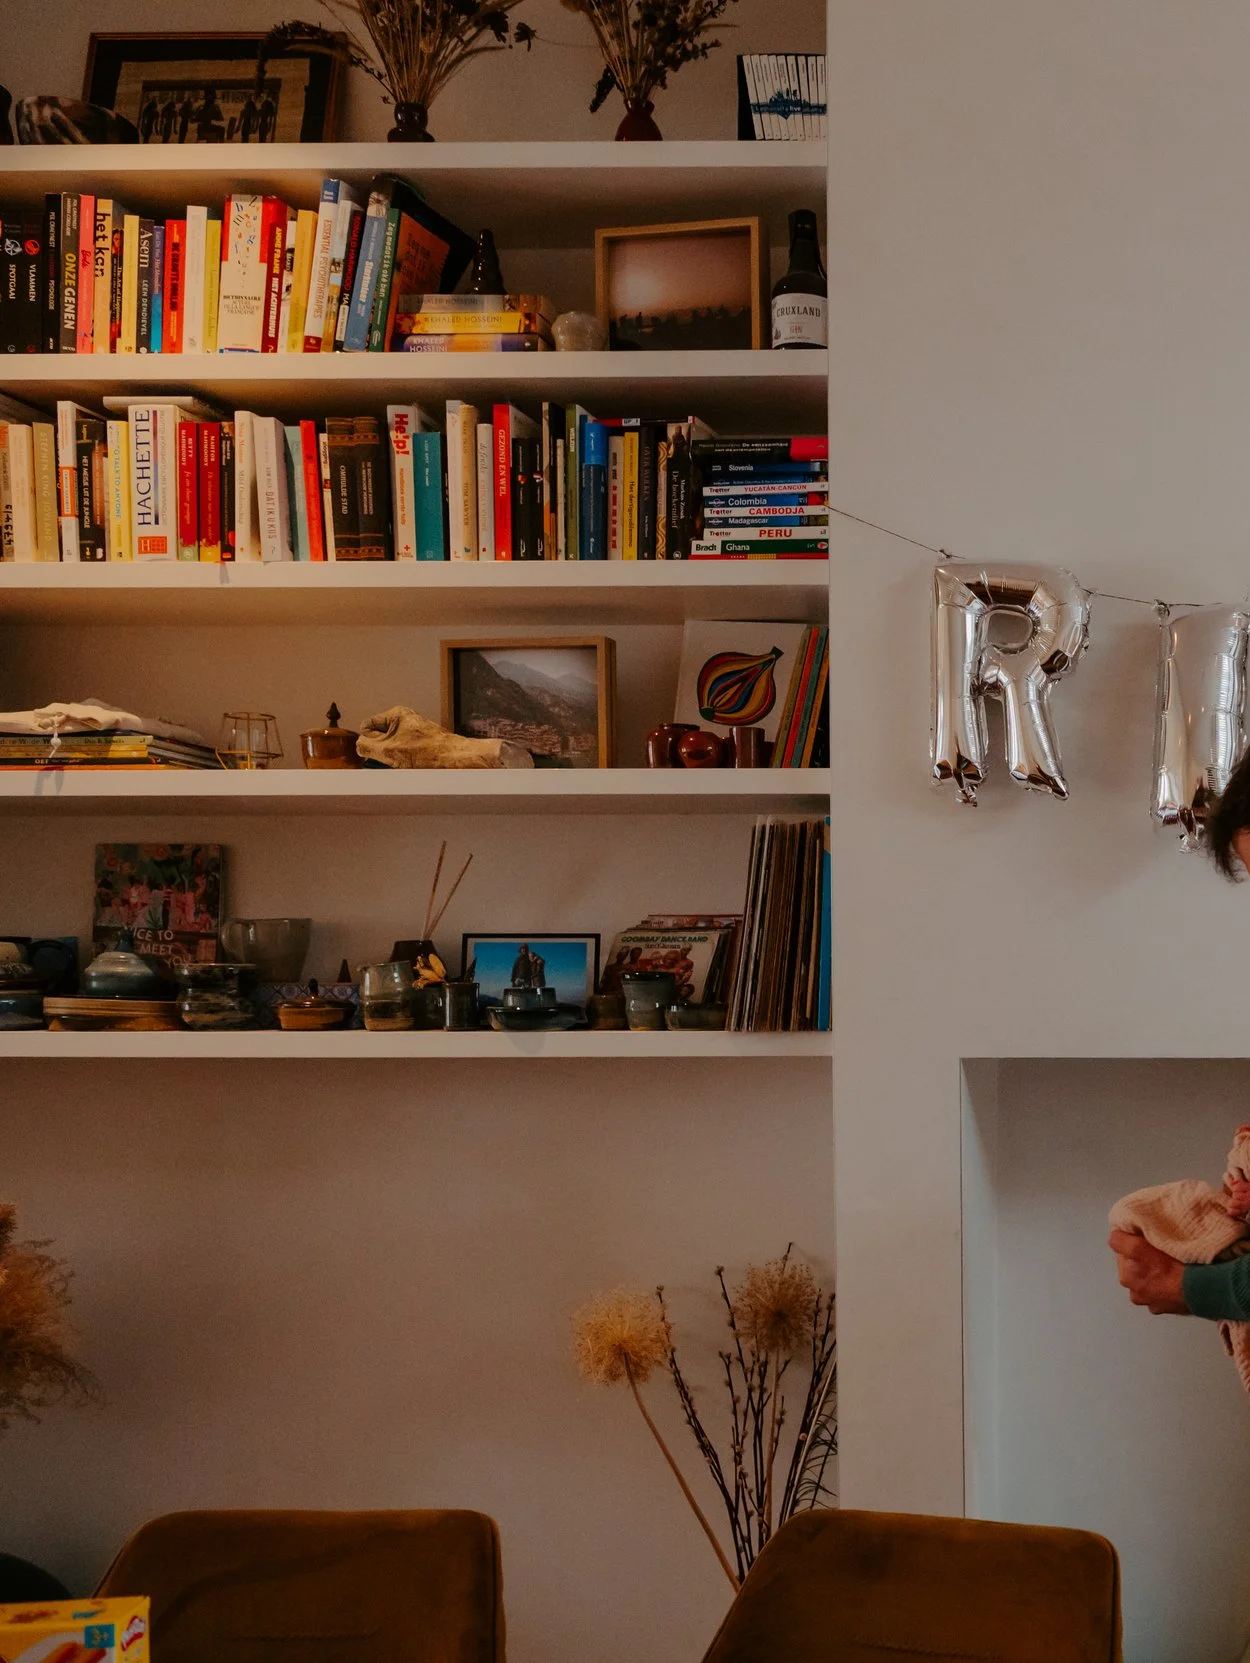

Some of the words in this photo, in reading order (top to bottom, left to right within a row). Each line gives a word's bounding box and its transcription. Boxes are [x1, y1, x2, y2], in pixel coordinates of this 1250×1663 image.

[96, 212, 110, 241] het
[320, 219, 332, 255] ESSENTIAL
[350, 215, 362, 248] RONALD
[139, 228, 152, 268] Asem
[64, 252, 77, 287] ONZE
[273, 249, 281, 274] FRANK
[343, 249, 356, 291] HARWOOD
[28, 264, 36, 301] VLAMMEN
[313, 256, 327, 319] PSYCHOTHERAPIES
[379, 283, 387, 297] ben
[64, 287, 76, 330] GENEN
[140, 298, 148, 336] DENDIEVEL
[268, 292, 278, 338] ACHTERHUIS
[777, 306, 820, 317] CRUXLAND
[39, 431, 50, 470] STEPHEN
[135, 410, 152, 526] HACHETTE
[499, 465, 506, 477] EN
[672, 471, 678, 482] De
[41, 475, 51, 497] KING
[114, 476, 120, 485] TO
[339, 465, 347, 496] OMHULDE
[83, 498, 90, 506] DE
[265, 491, 274, 506] DAT
[42, 501, 52, 542] JOYLAND
[83, 507, 91, 528] JUNGLE
[266, 508, 275, 516] IK
[728, 517, 769, 525] Madagascar
[749, 507, 804, 515] CAMBODJA
[267, 525, 277, 539] KUS
[759, 529, 792, 538] PERU
[725, 543, 750, 551] Ghana
[157, 930, 174, 941] TO
[140, 943, 174, 955] MEET
